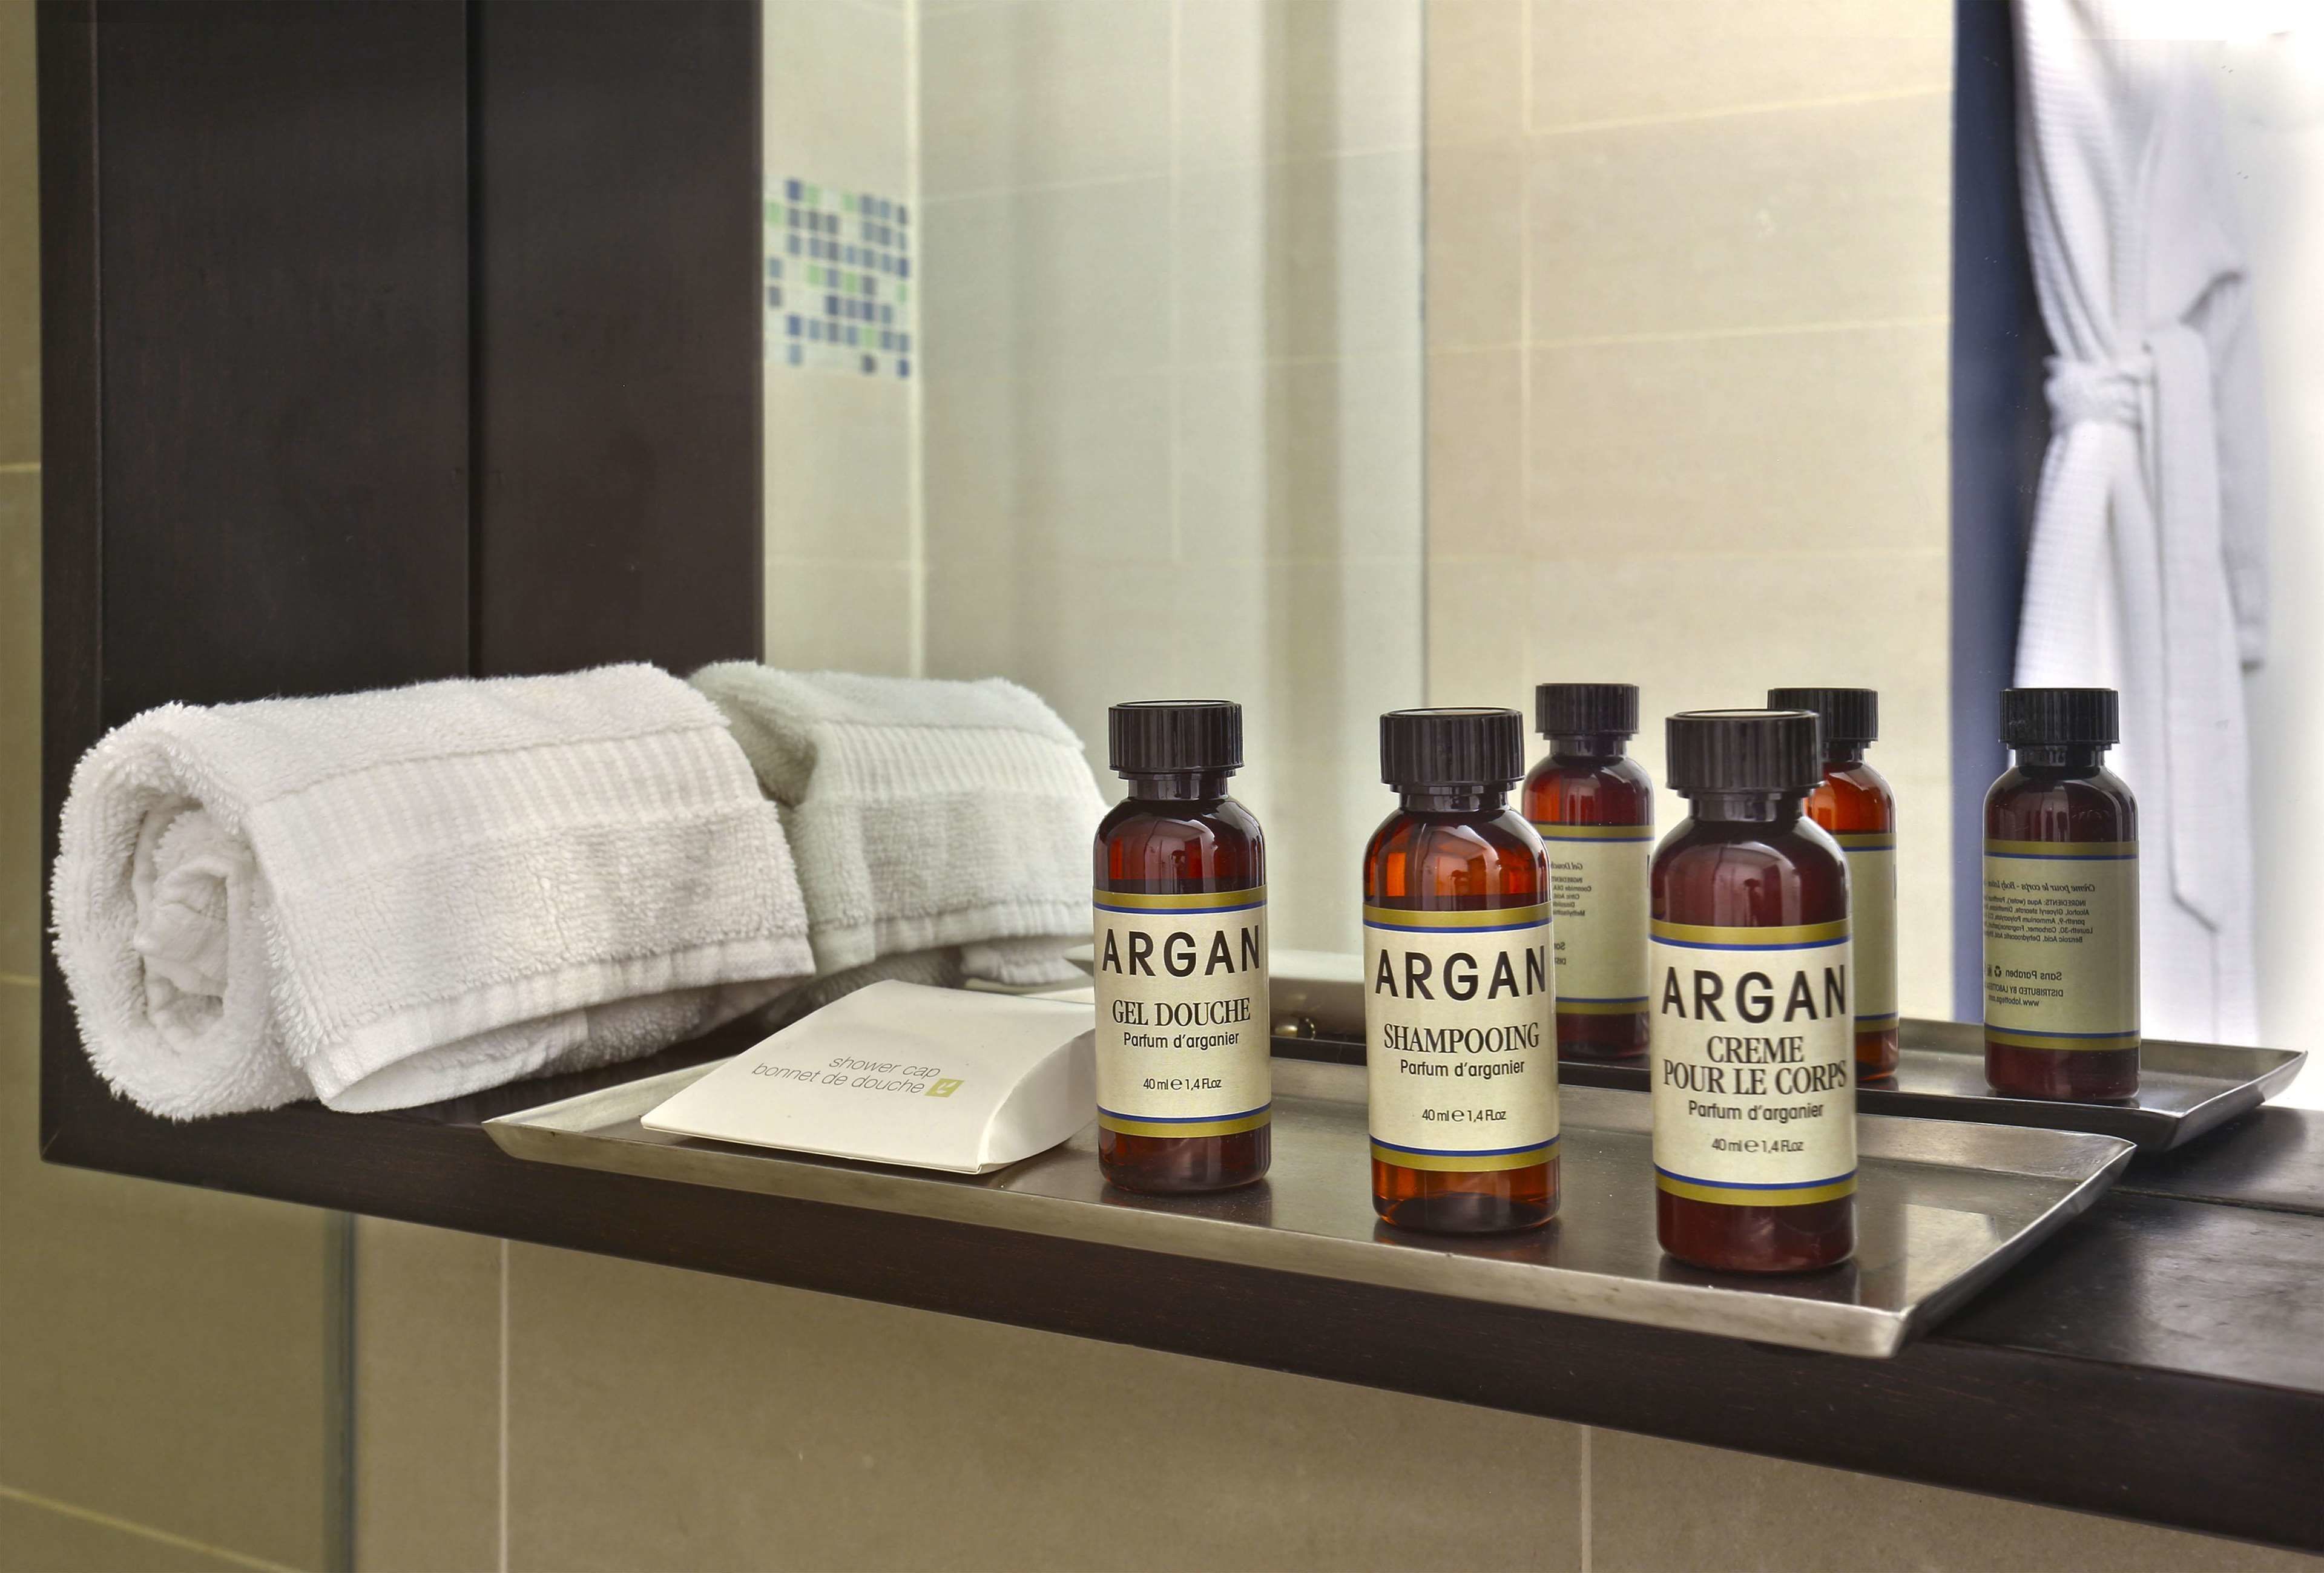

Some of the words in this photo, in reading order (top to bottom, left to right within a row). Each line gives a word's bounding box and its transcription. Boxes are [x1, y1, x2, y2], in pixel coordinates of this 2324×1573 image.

[1102, 925, 1260, 977] ARGAN
[1375, 945, 1545, 1001] ARGAN
[1662, 965, 1846, 1023] ARGAN
[1112, 999, 1148, 1026] GEL
[1154, 997, 1251, 1026] DOUCHE
[1124, 1032, 1168, 1048] Parfum
[1174, 1032, 1239, 1050] d'arganier
[1384, 1022, 1539, 1054] SHAMPOOING
[1707, 1036, 1804, 1064] CREME
[752, 1063, 820, 1082] bonnet
[821, 1072, 848, 1086] de
[852, 1075, 924, 1094] douche
[829, 1056, 901, 1073] shower
[903, 1065, 940, 1079] cap
[1400, 1059, 1449, 1077] Parfum
[1454, 1060, 1525, 1079] d'arganier
[1663, 1059, 1726, 1094] POUR
[1733, 1068, 1766, 1095] LE
[1774, 1060, 1846, 1095] CORPS
[1144, 1079, 1156, 1089] 40
[1157, 1079, 1168, 1090] ml
[1185, 1079, 1199, 1091] 1,4
[1422, 1109, 1435, 1121] 40
[1437, 1110, 1449, 1121] ml
[1467, 1110, 1483, 1123] 1,4
[1688, 1100, 1742, 1120] Parfum
[1748, 1102, 1825, 1123] d'arganier
[1712, 1138, 1727, 1151] 40
[1728, 1140, 1743, 1152] ml
[1761, 1140, 1779, 1154] 1,4
